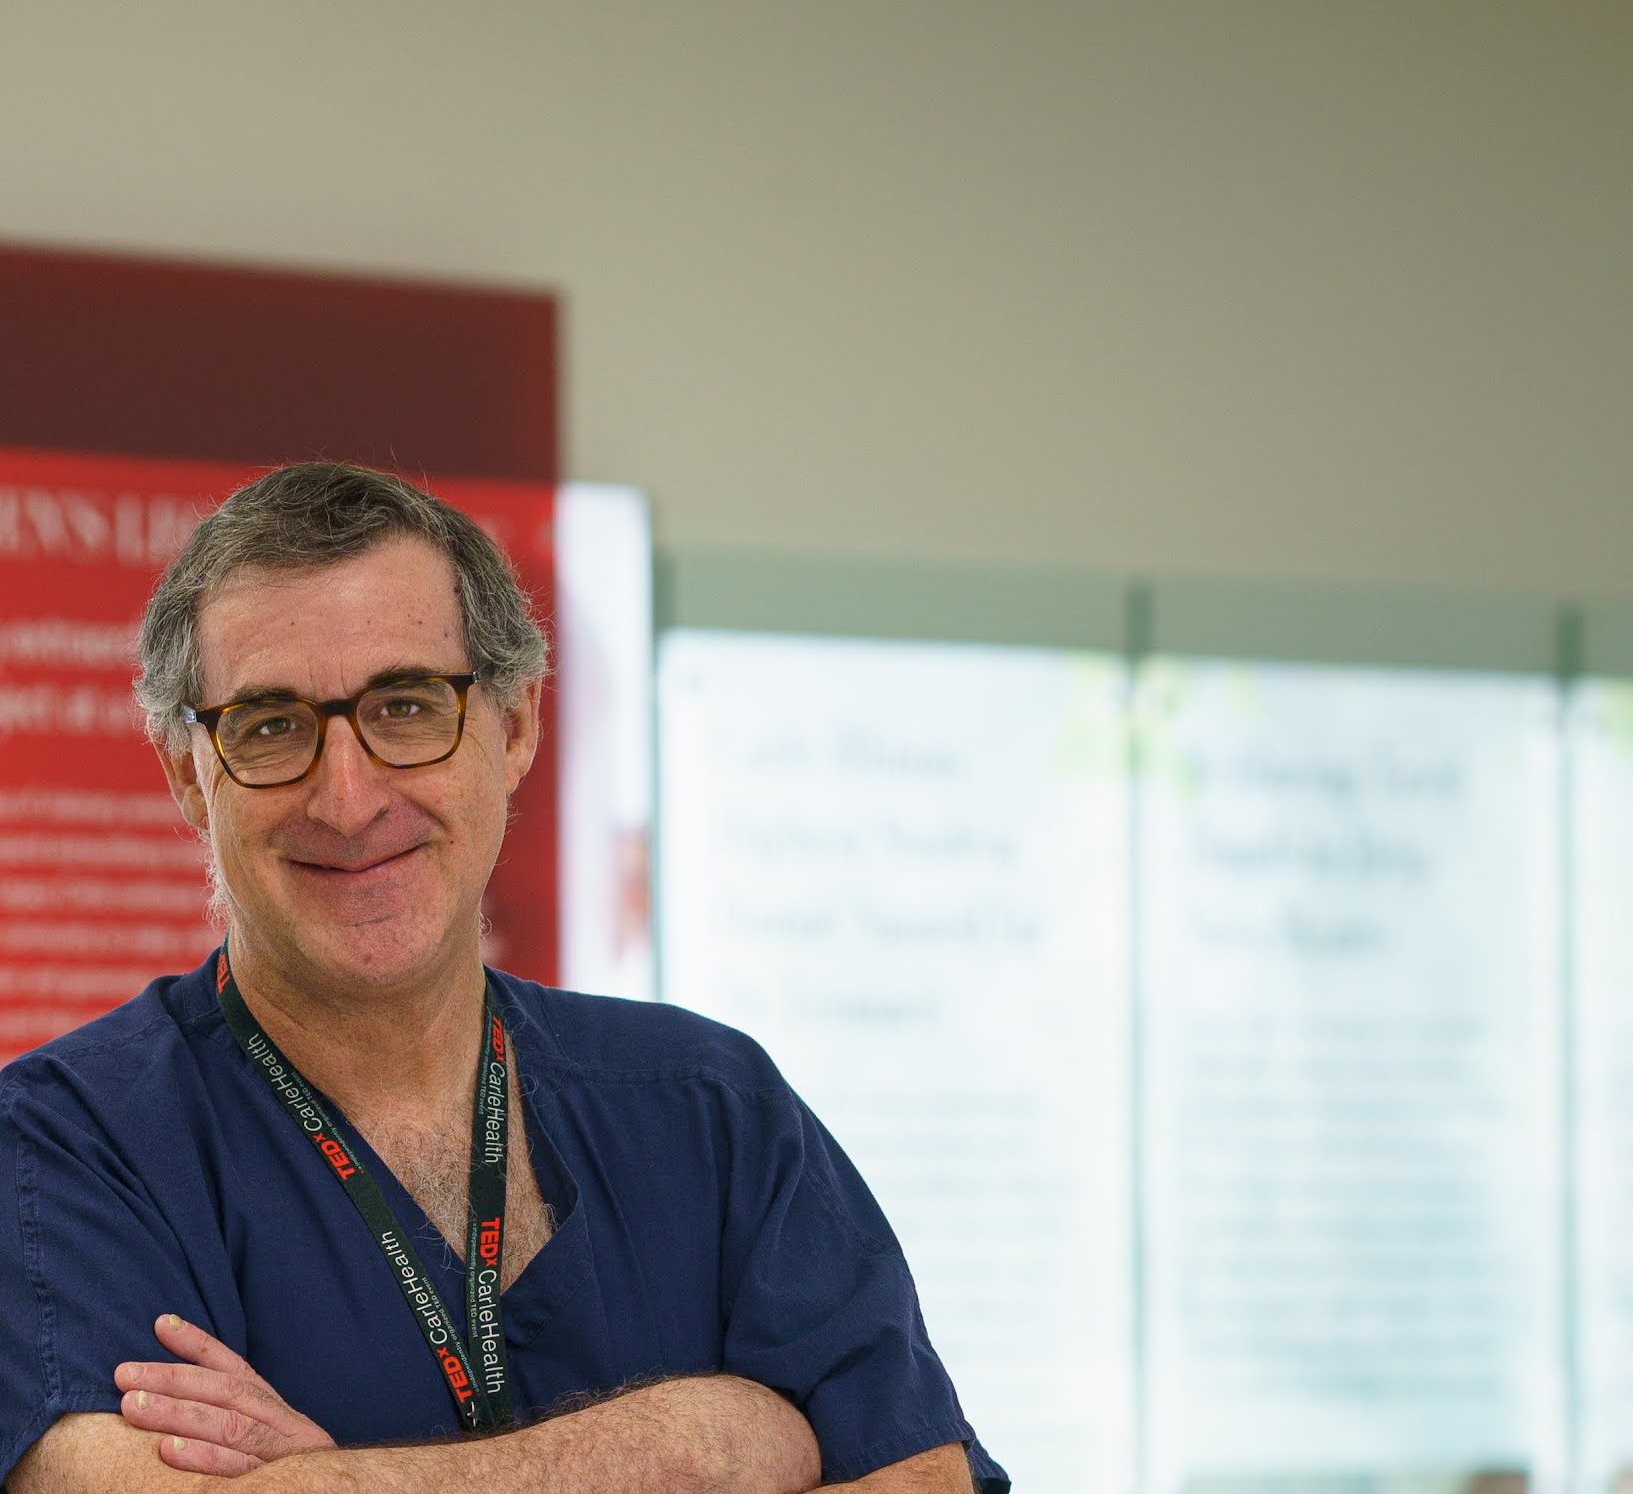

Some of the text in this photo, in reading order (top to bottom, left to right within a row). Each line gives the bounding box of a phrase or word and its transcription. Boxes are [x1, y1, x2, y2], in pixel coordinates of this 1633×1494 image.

[247, 1032, 324, 1133] CarleHealth
[484, 1061, 506, 1164] CarleHealth
[381, 1230, 448, 1345] CarleHealth
[477, 1268, 505, 1394] CarleHealth
